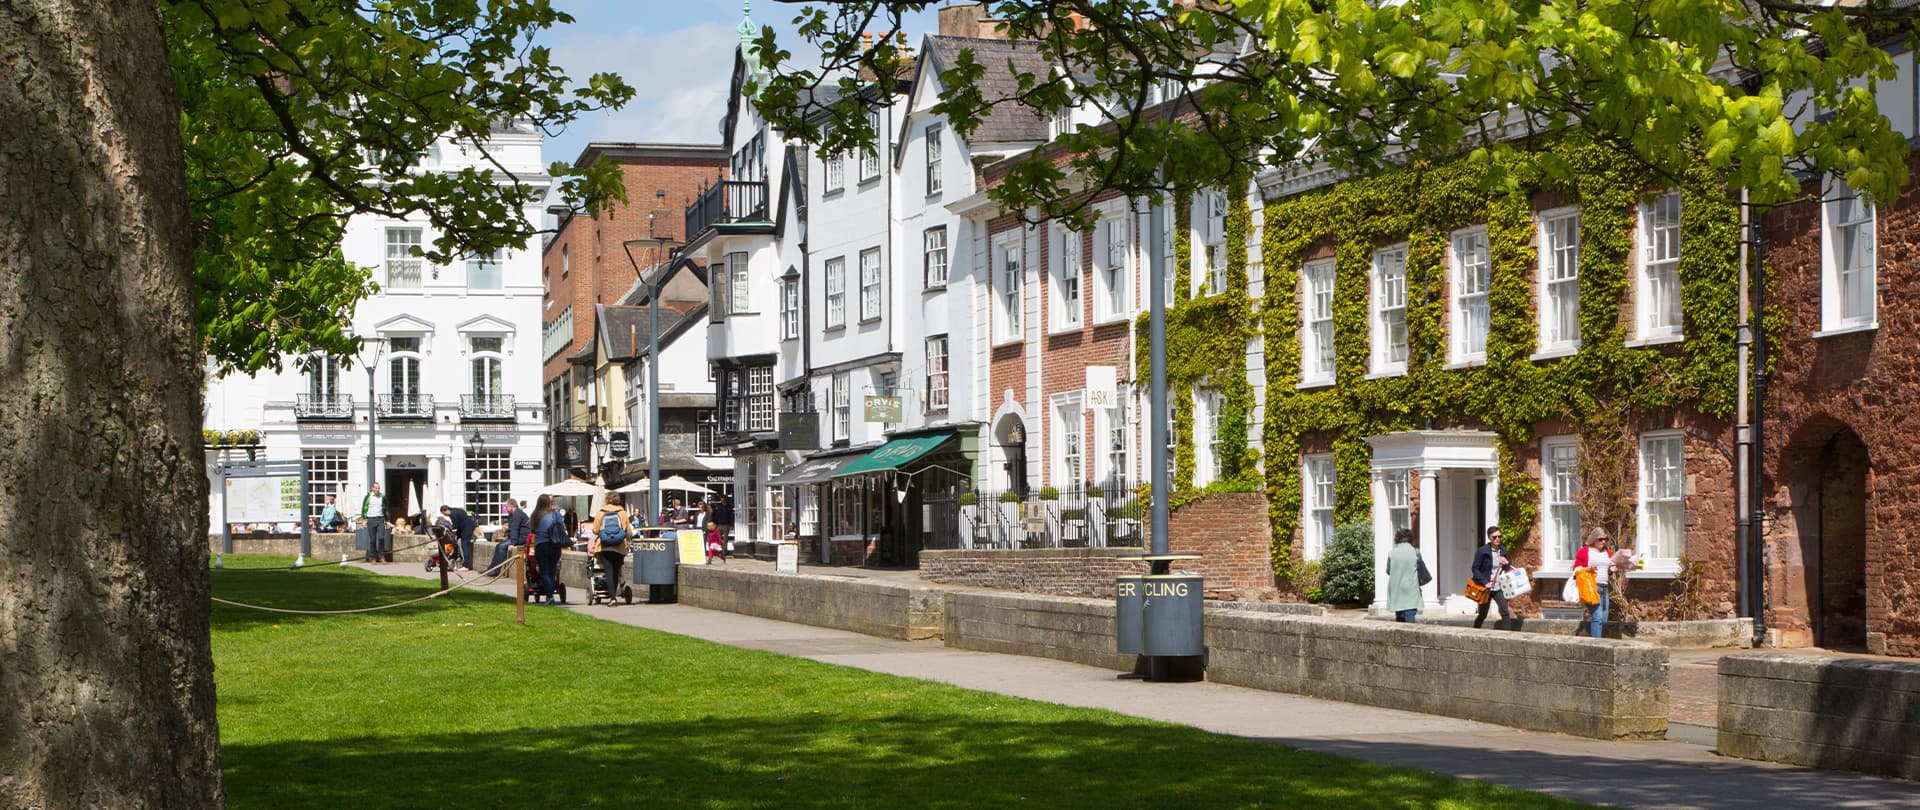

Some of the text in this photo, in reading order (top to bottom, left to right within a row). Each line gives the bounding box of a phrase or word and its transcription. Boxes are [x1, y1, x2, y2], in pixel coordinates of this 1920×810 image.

[865, 398, 900, 408] ORVIS
[1091, 391, 1108, 405] ASK
[1117, 583, 1136, 597] ER
